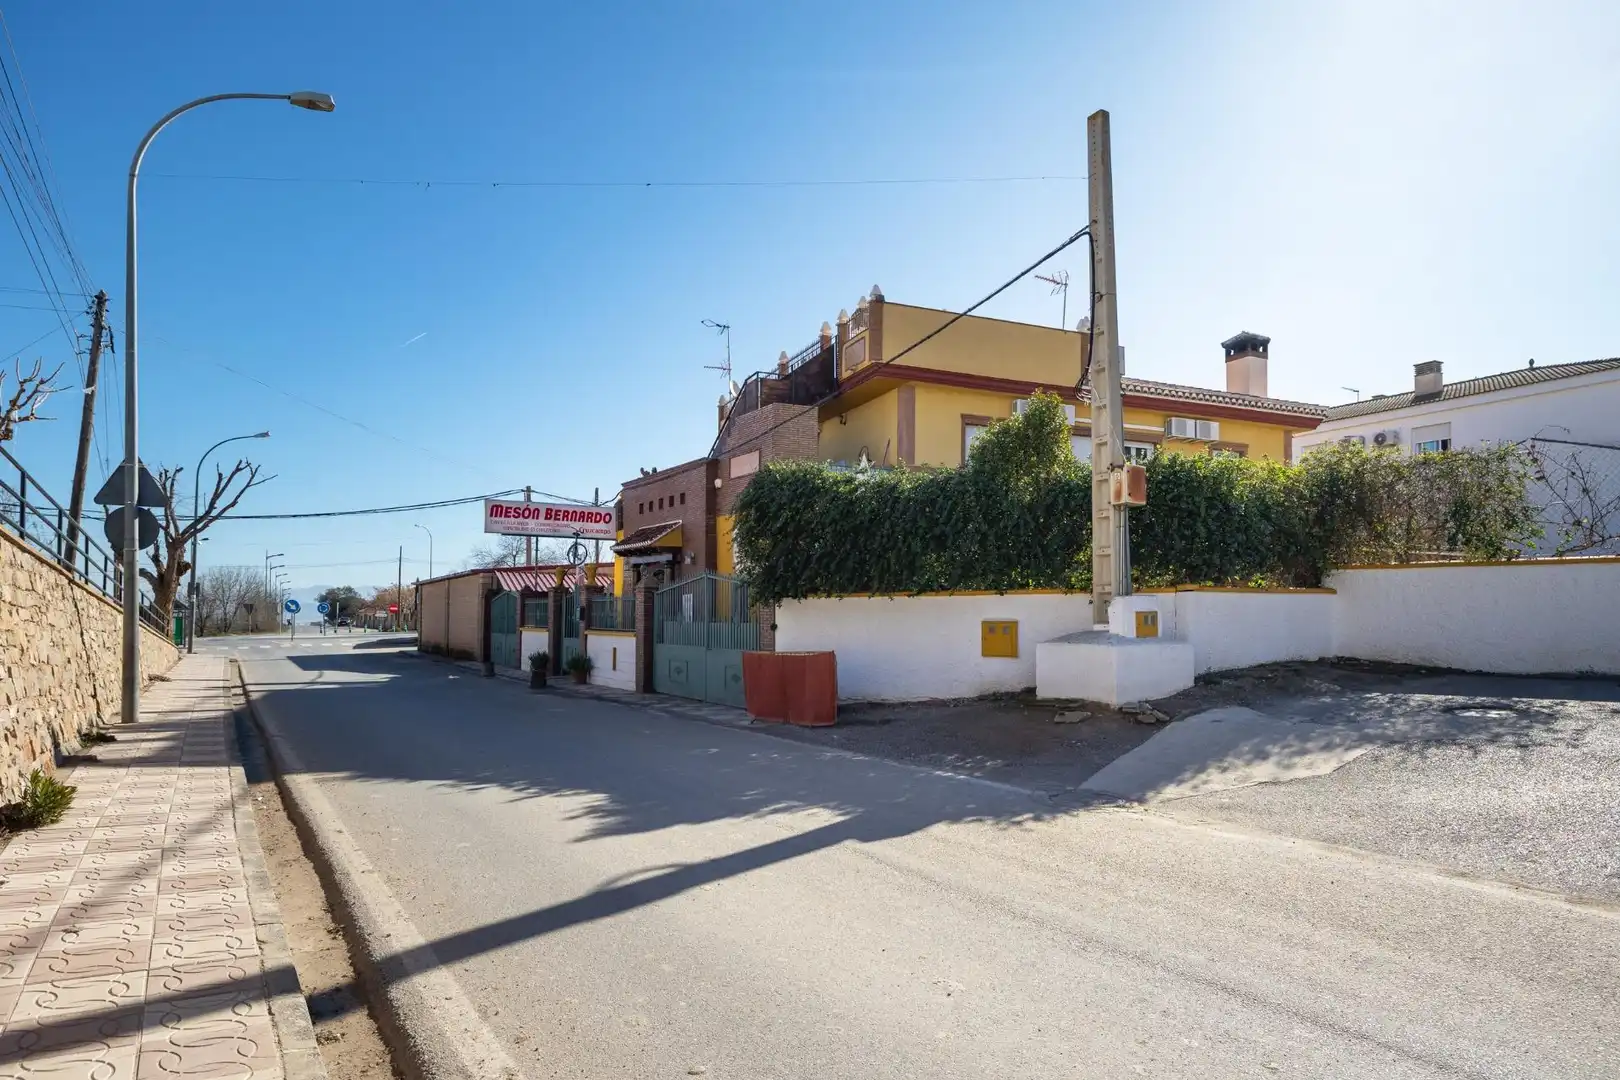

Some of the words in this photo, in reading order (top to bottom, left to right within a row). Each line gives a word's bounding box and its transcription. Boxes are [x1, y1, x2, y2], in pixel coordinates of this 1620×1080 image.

[489, 504, 540, 520] MESÓN
[544, 508, 613, 524] BERNARDO
[578, 526, 611, 535] Cruzcampo
